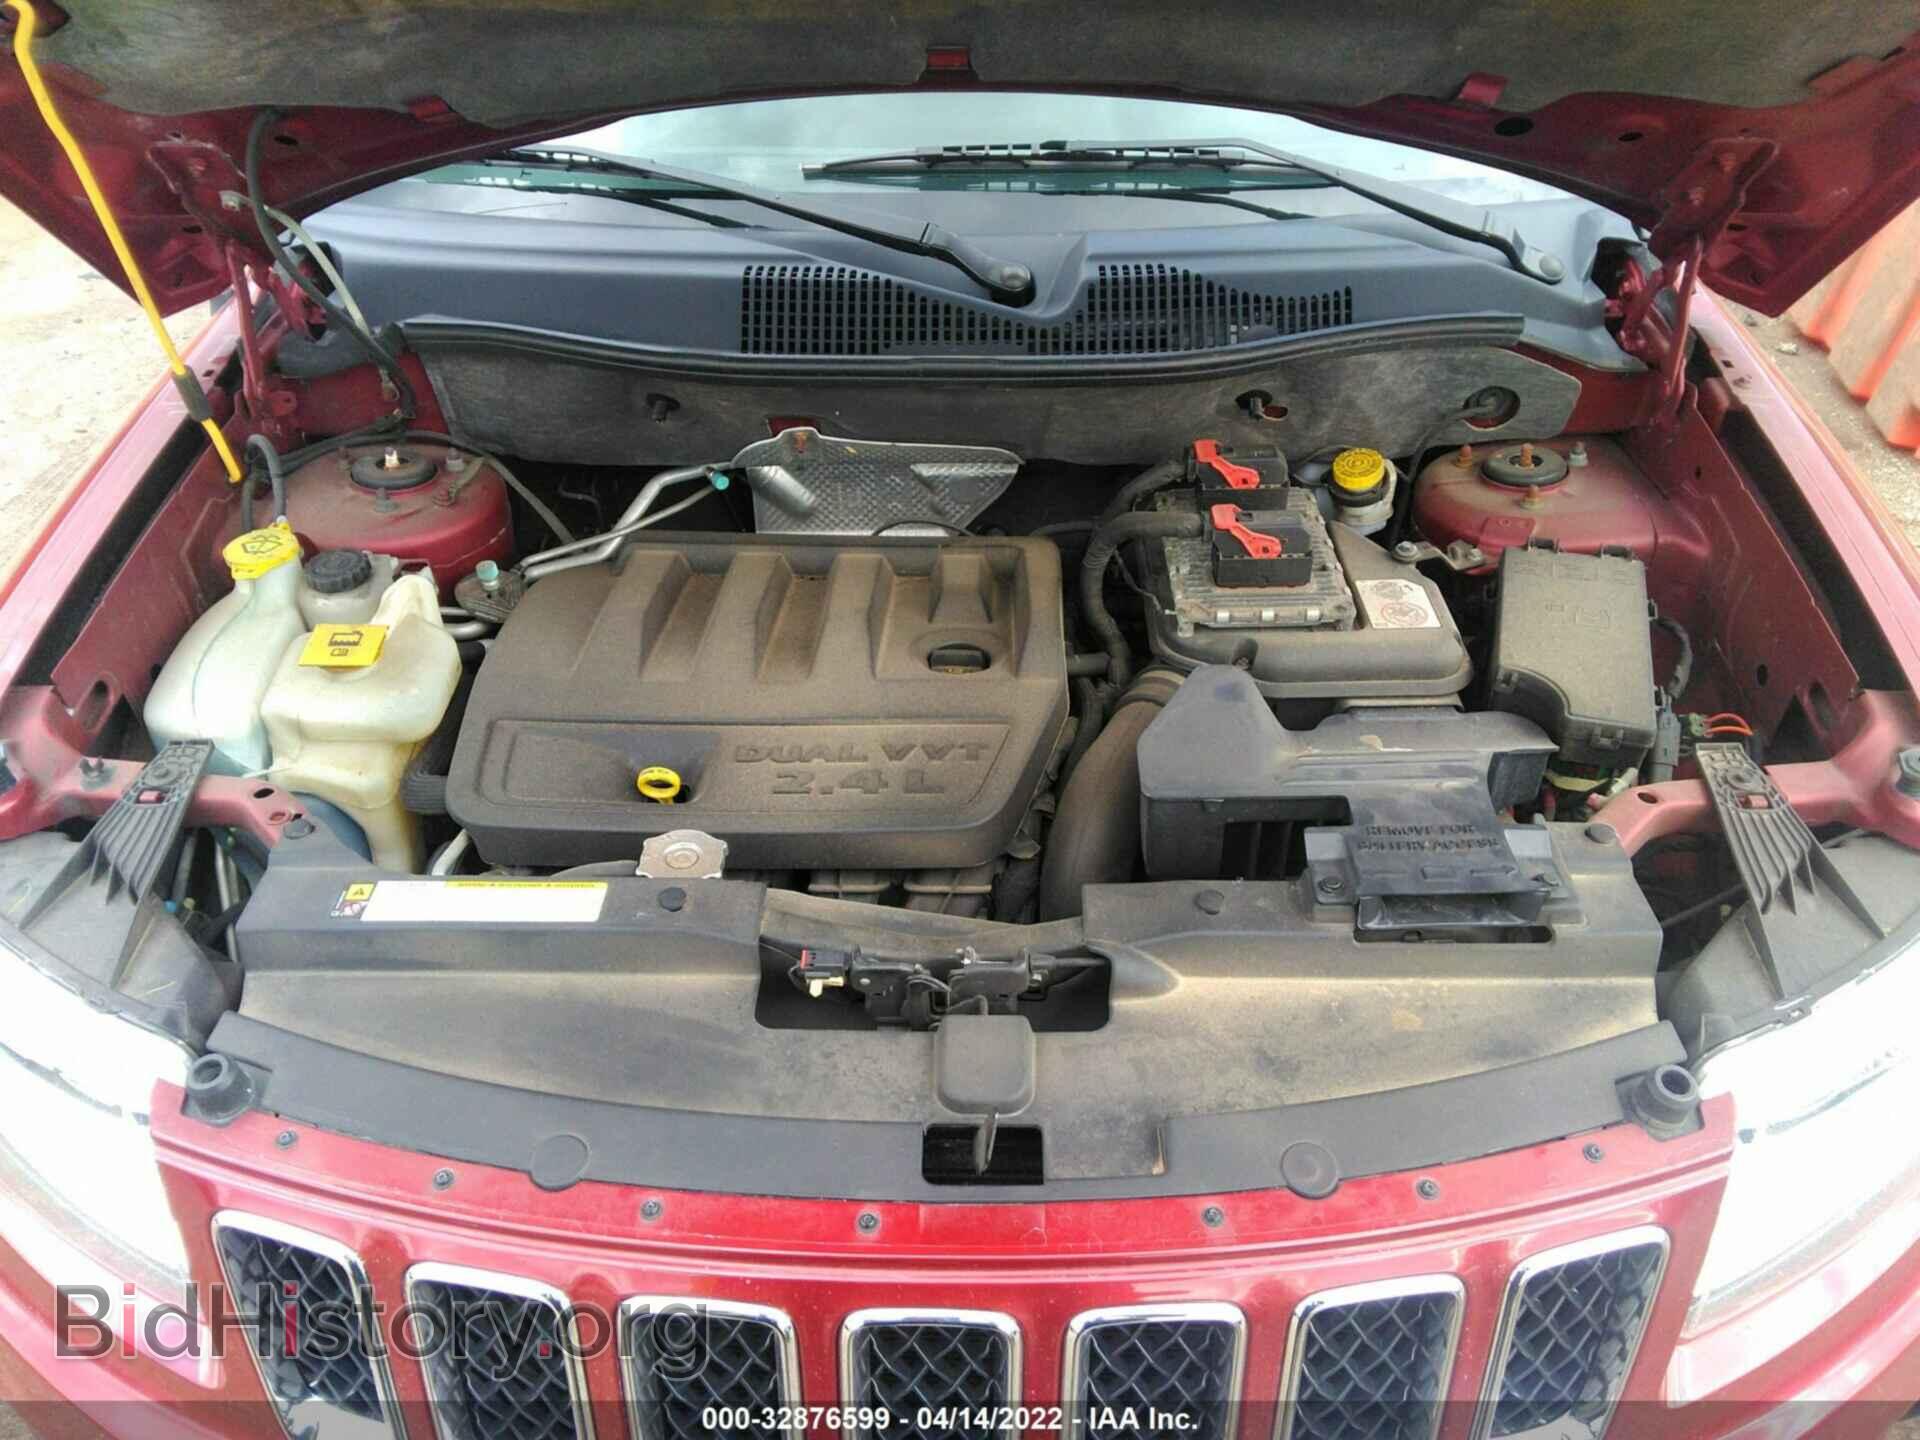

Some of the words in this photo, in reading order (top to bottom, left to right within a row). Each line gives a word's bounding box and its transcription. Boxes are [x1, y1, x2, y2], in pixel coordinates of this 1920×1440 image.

[735, 743, 869, 763] DUAL
[880, 743, 987, 763] VVT
[1437, 823, 1476, 835] FOR
